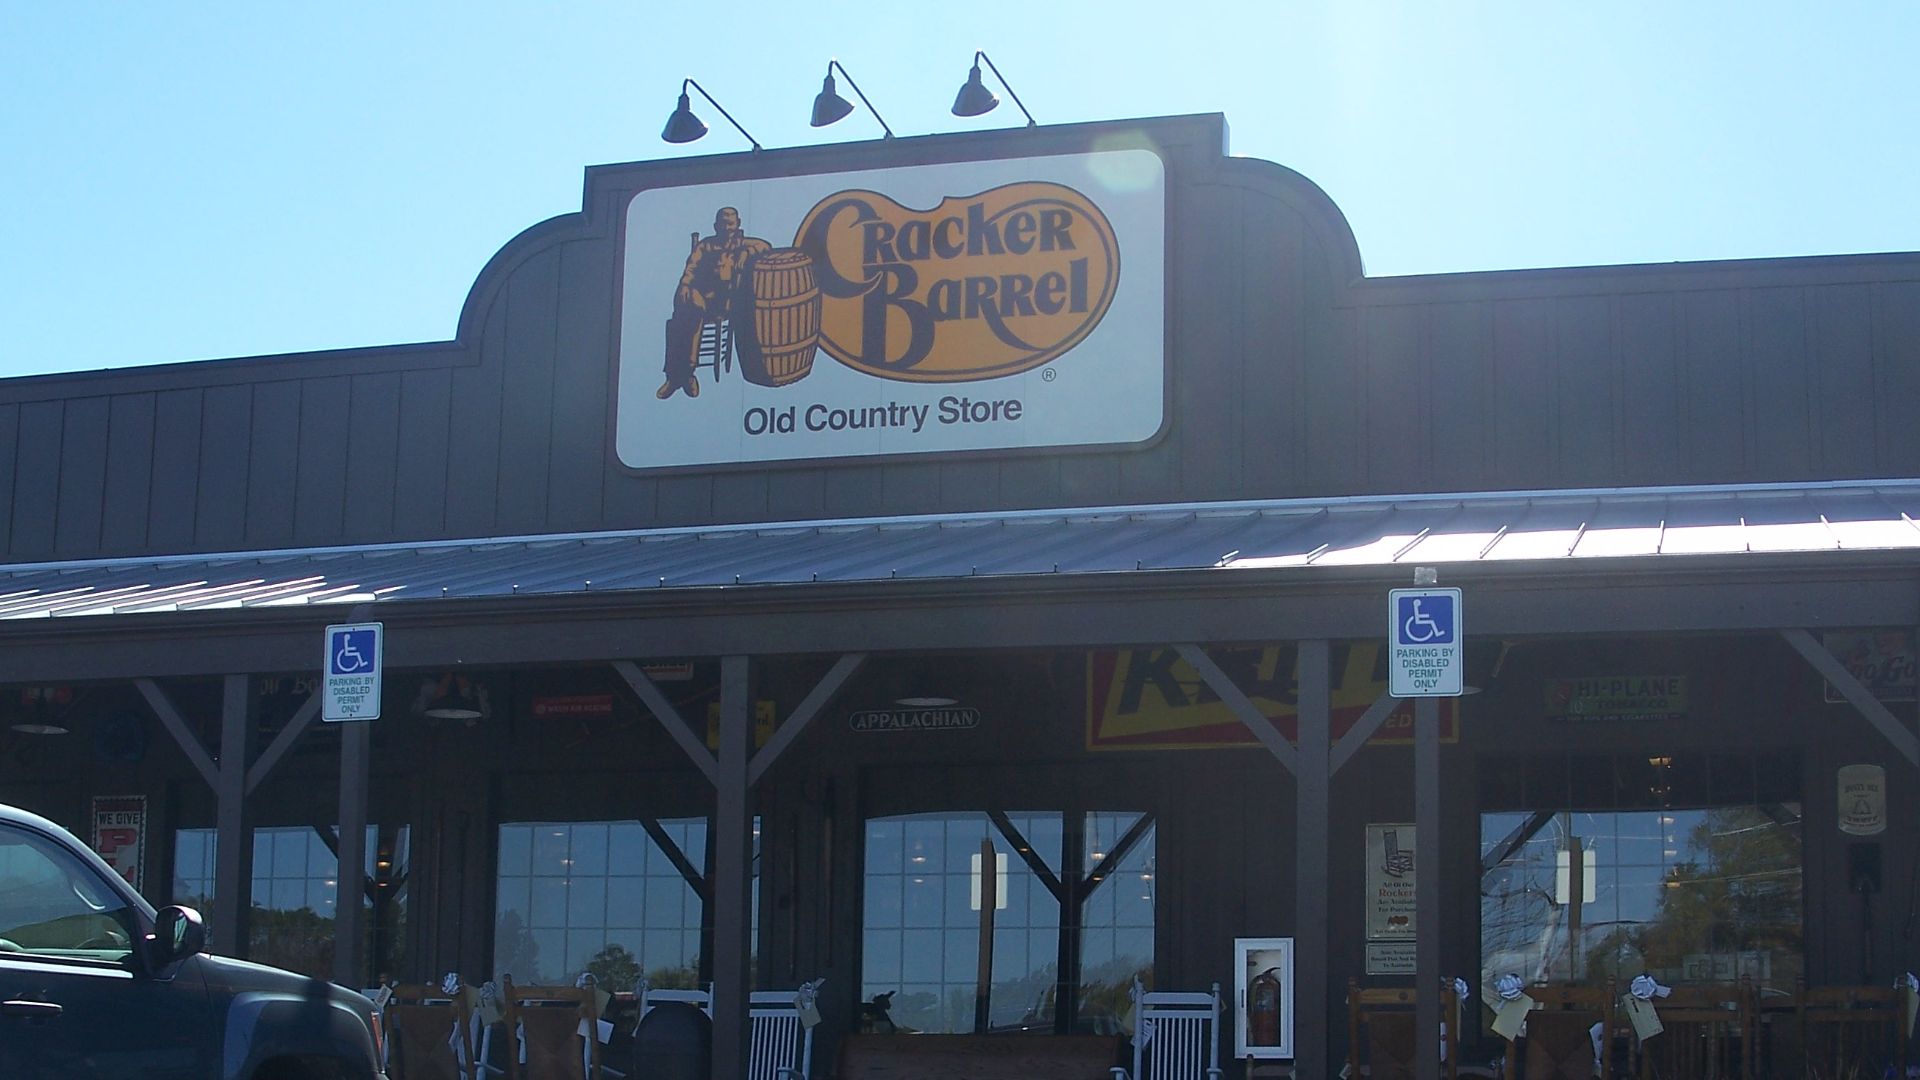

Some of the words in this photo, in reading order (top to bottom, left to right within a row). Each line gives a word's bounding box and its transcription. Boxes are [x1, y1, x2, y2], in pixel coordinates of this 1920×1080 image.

[807, 198, 1077, 300] Cracker
[861, 256, 1089, 371] Barrel
[744, 406, 796, 436] Old
[804, 403, 929, 433] Country
[938, 396, 1023, 424] Store
[1396, 648, 1438, 658] PARKING
[1442, 648, 1455, 657] BY
[1402, 658, 1450, 668] DISABLED
[1408, 669, 1443, 678] PERMIT
[329, 677, 362, 687] PARKING
[364, 676, 375, 685] BY
[1413, 680, 1438, 688] ONLY
[333, 686, 370, 696] DISABLED
[1578, 678, 1680, 697] HI-PLANE
[337, 695, 365, 704] PERMIT
[341, 705, 361, 713] ONLY
[856, 710, 973, 728] APPALACHIAN
[99, 813, 113, 825] WE
[116, 812, 139, 824] GIVE
